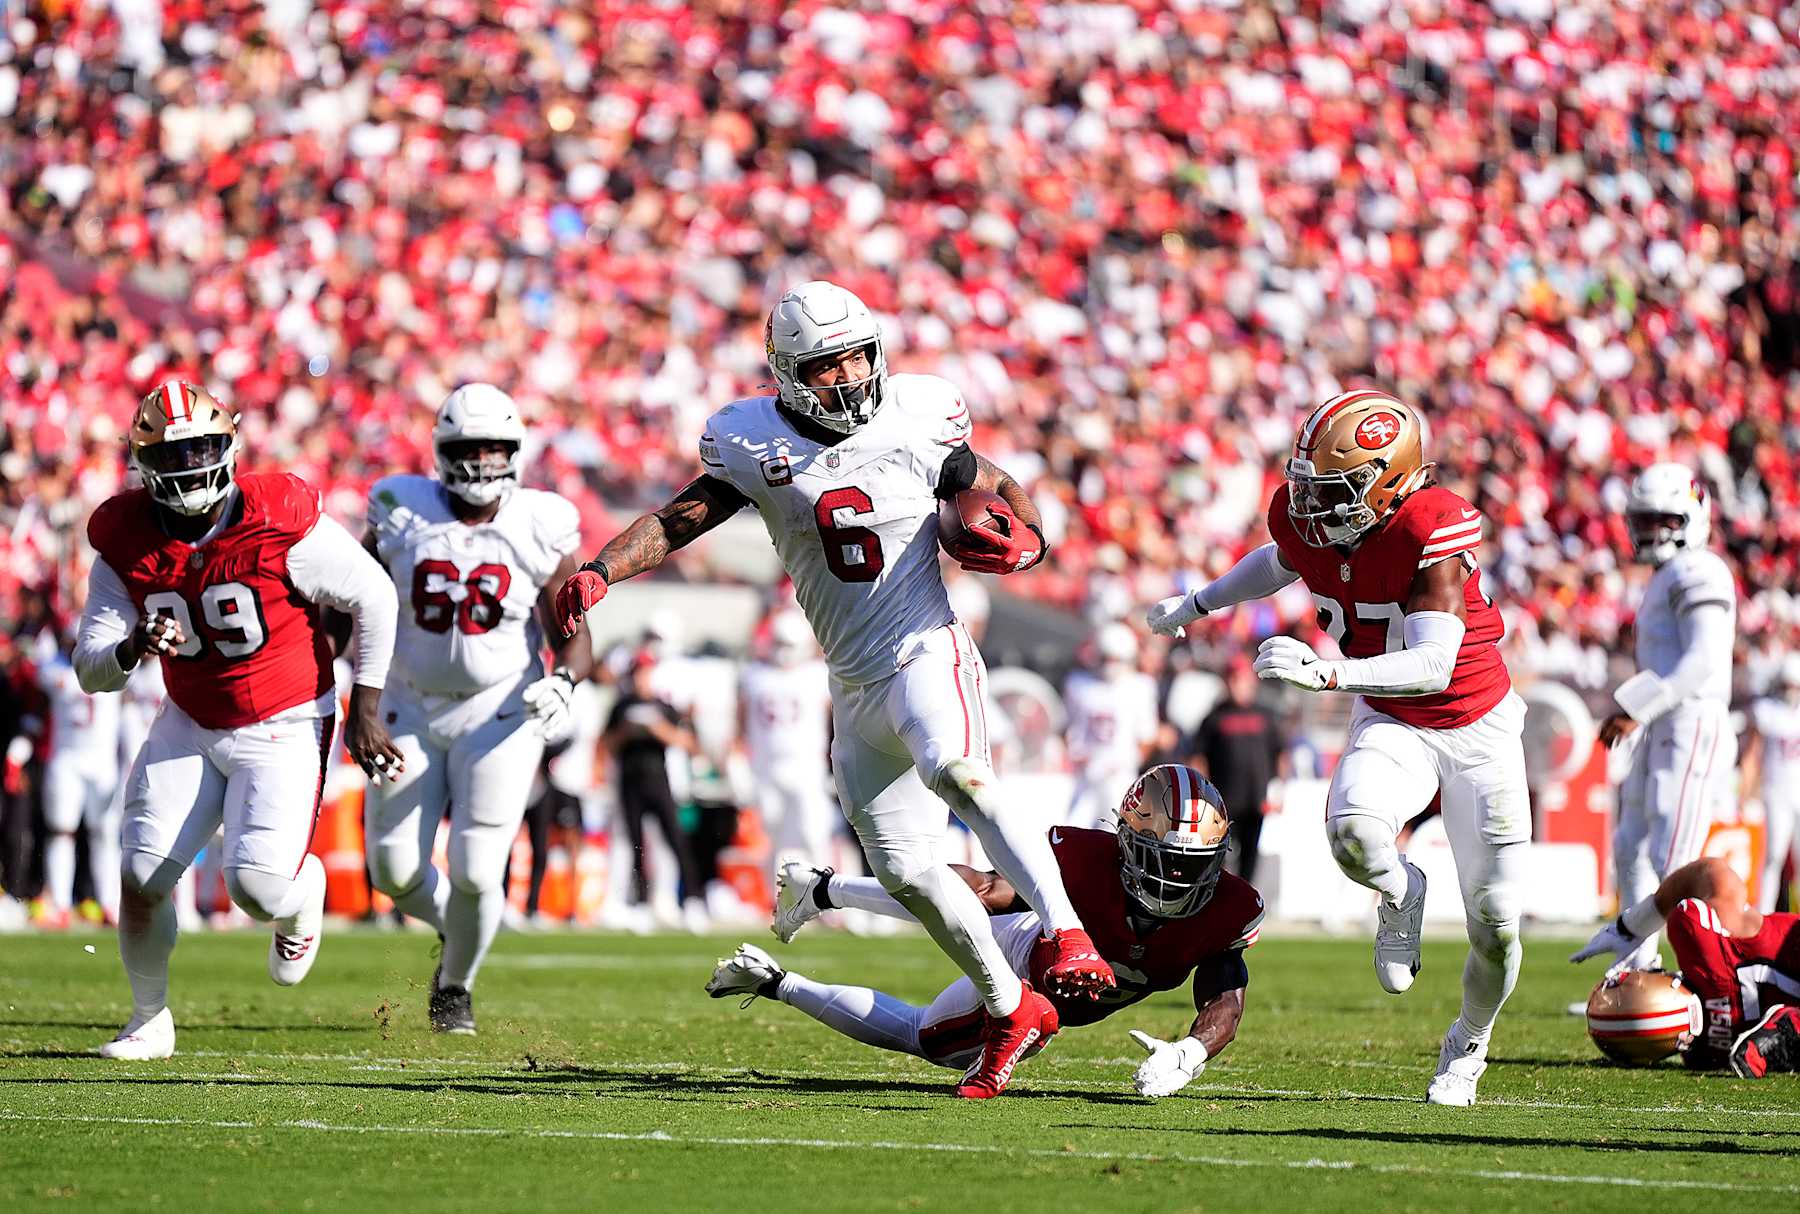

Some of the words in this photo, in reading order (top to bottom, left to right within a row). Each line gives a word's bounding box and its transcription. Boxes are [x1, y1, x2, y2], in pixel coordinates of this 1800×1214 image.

[763, 459, 789, 481] C
[814, 485, 885, 583] 6
[411, 558, 512, 636] 68
